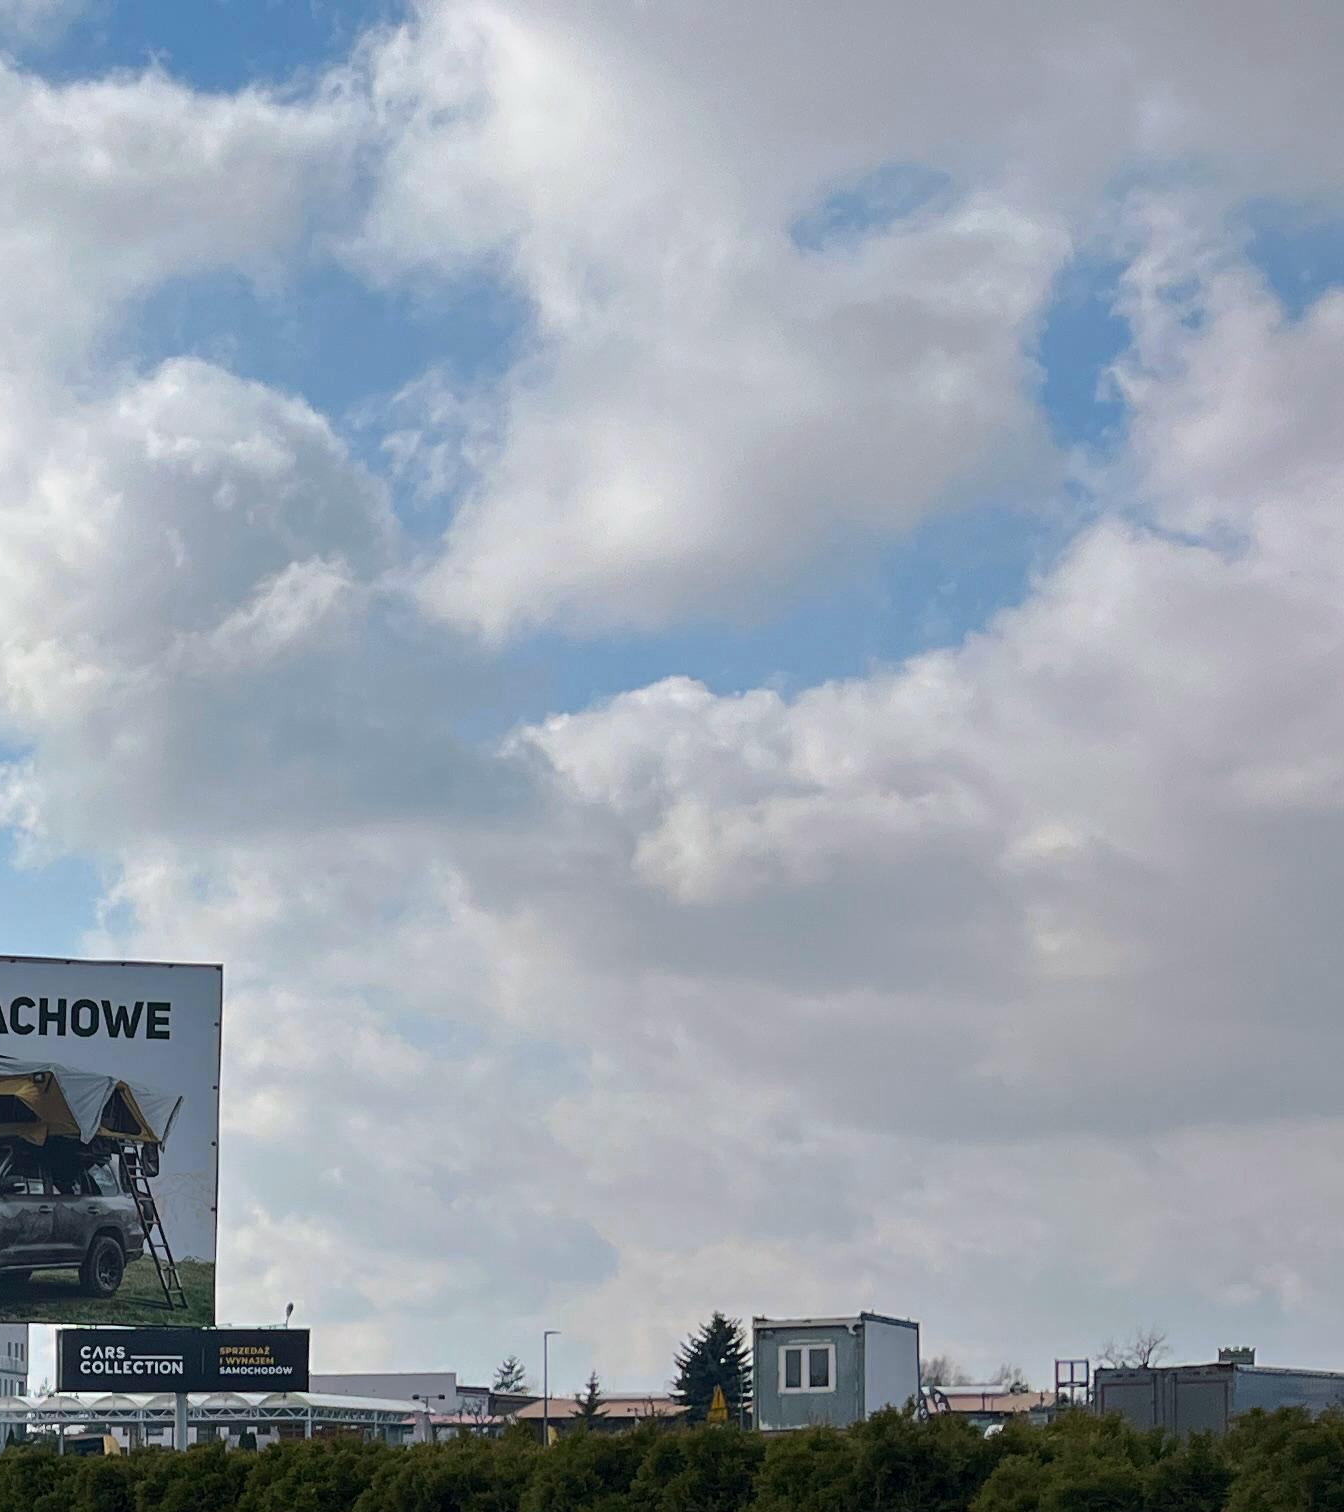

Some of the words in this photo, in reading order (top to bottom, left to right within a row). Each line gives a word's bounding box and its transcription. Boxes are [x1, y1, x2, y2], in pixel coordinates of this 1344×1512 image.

[80, 1346, 126, 1360] CARS
[219, 1346, 271, 1355] SPRZEDAŻ
[226, 1357, 275, 1365] WYNAJEM
[80, 1361, 184, 1375] COLLECTION
[219, 1366, 294, 1375] SAMOCHODÓW
